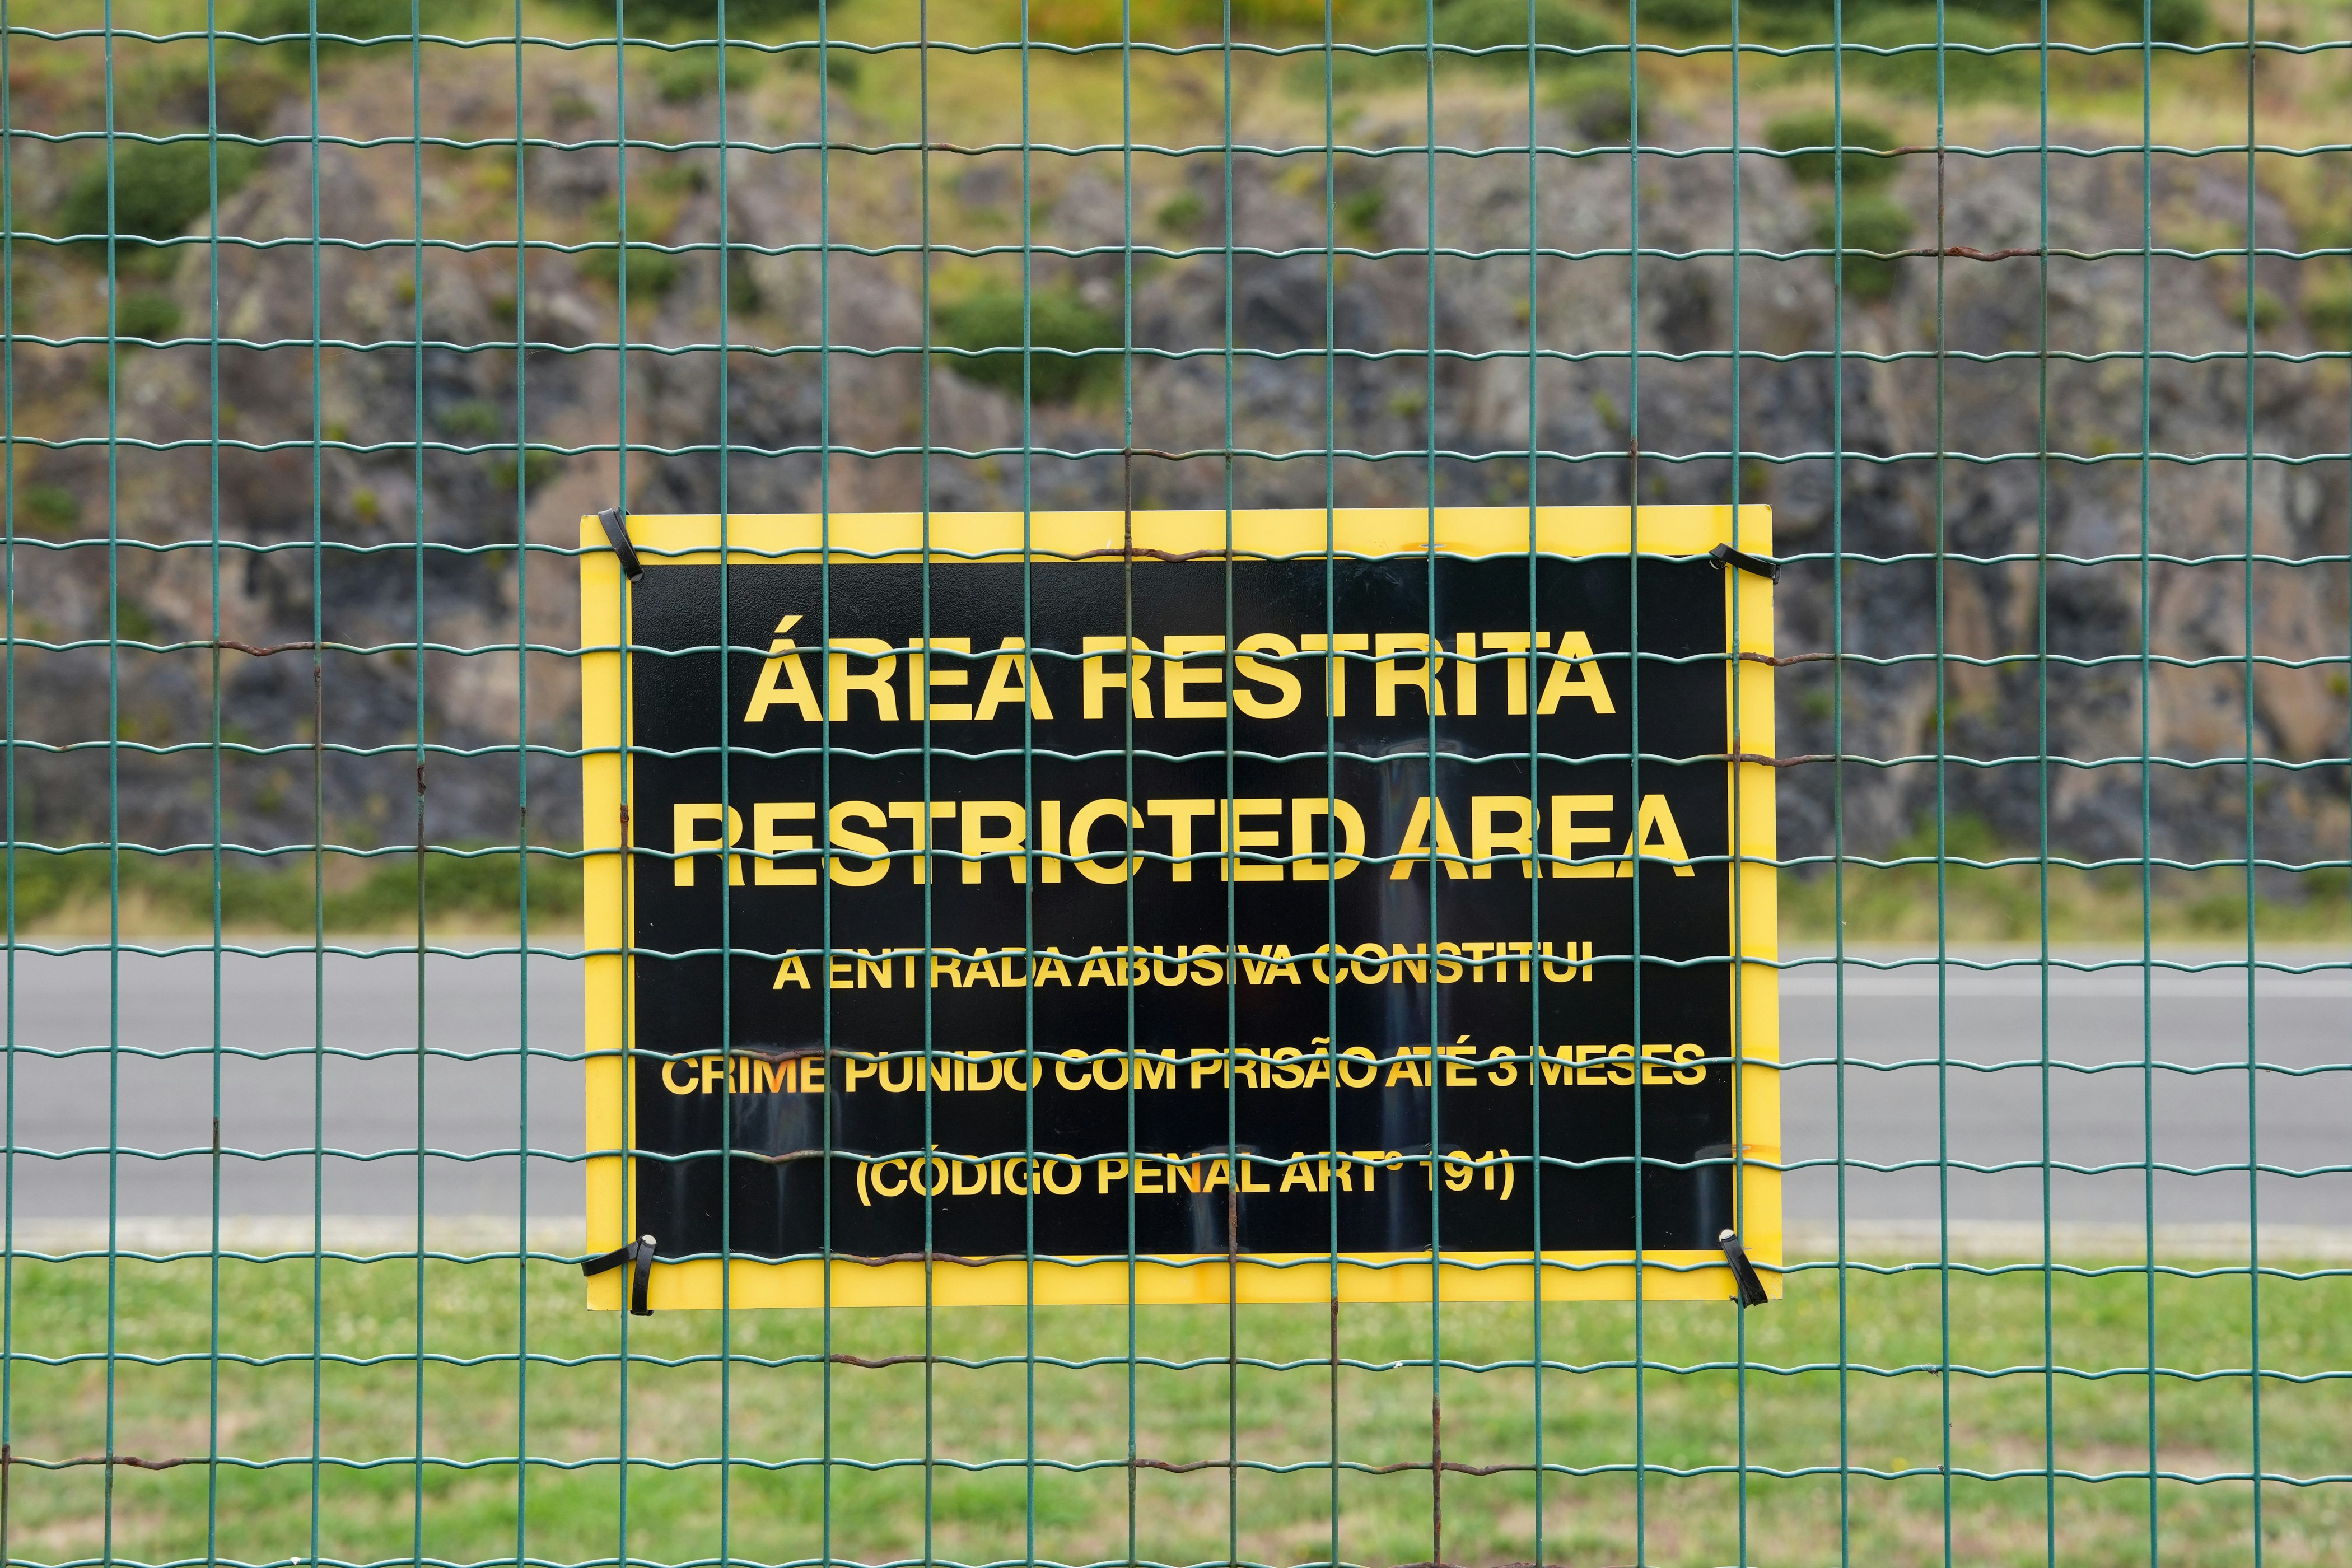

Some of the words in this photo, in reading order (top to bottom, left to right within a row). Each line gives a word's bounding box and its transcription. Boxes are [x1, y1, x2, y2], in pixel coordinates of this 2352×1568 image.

[744, 615, 1053, 721] ÁREA
[1083, 631, 1615, 719] RESTRITA
[674, 798, 1365, 886] RESTRICTED
[1389, 795, 1695, 880] AREA
[773, 949, 811, 989] A
[824, 947, 1072, 988] ENTRADA
[1078, 945, 1301, 986] ABUSVA
[1312, 942, 1592, 984] CONSTITUI
[662, 1053, 828, 1094] CRIME
[846, 1049, 1042, 1092] PUNIDO
[1055, 1048, 1175, 1090] COM
[1191, 1037, 1378, 1089] PRISÃO
[1385, 1035, 1477, 1087] ATÉ
[1488, 1046, 1518, 1086] 3
[1530, 1044, 1706, 1085] MESES
[857, 1144, 1082, 1206] (CÓDIGO
[1098, 1152, 1270, 1194] PENAL
